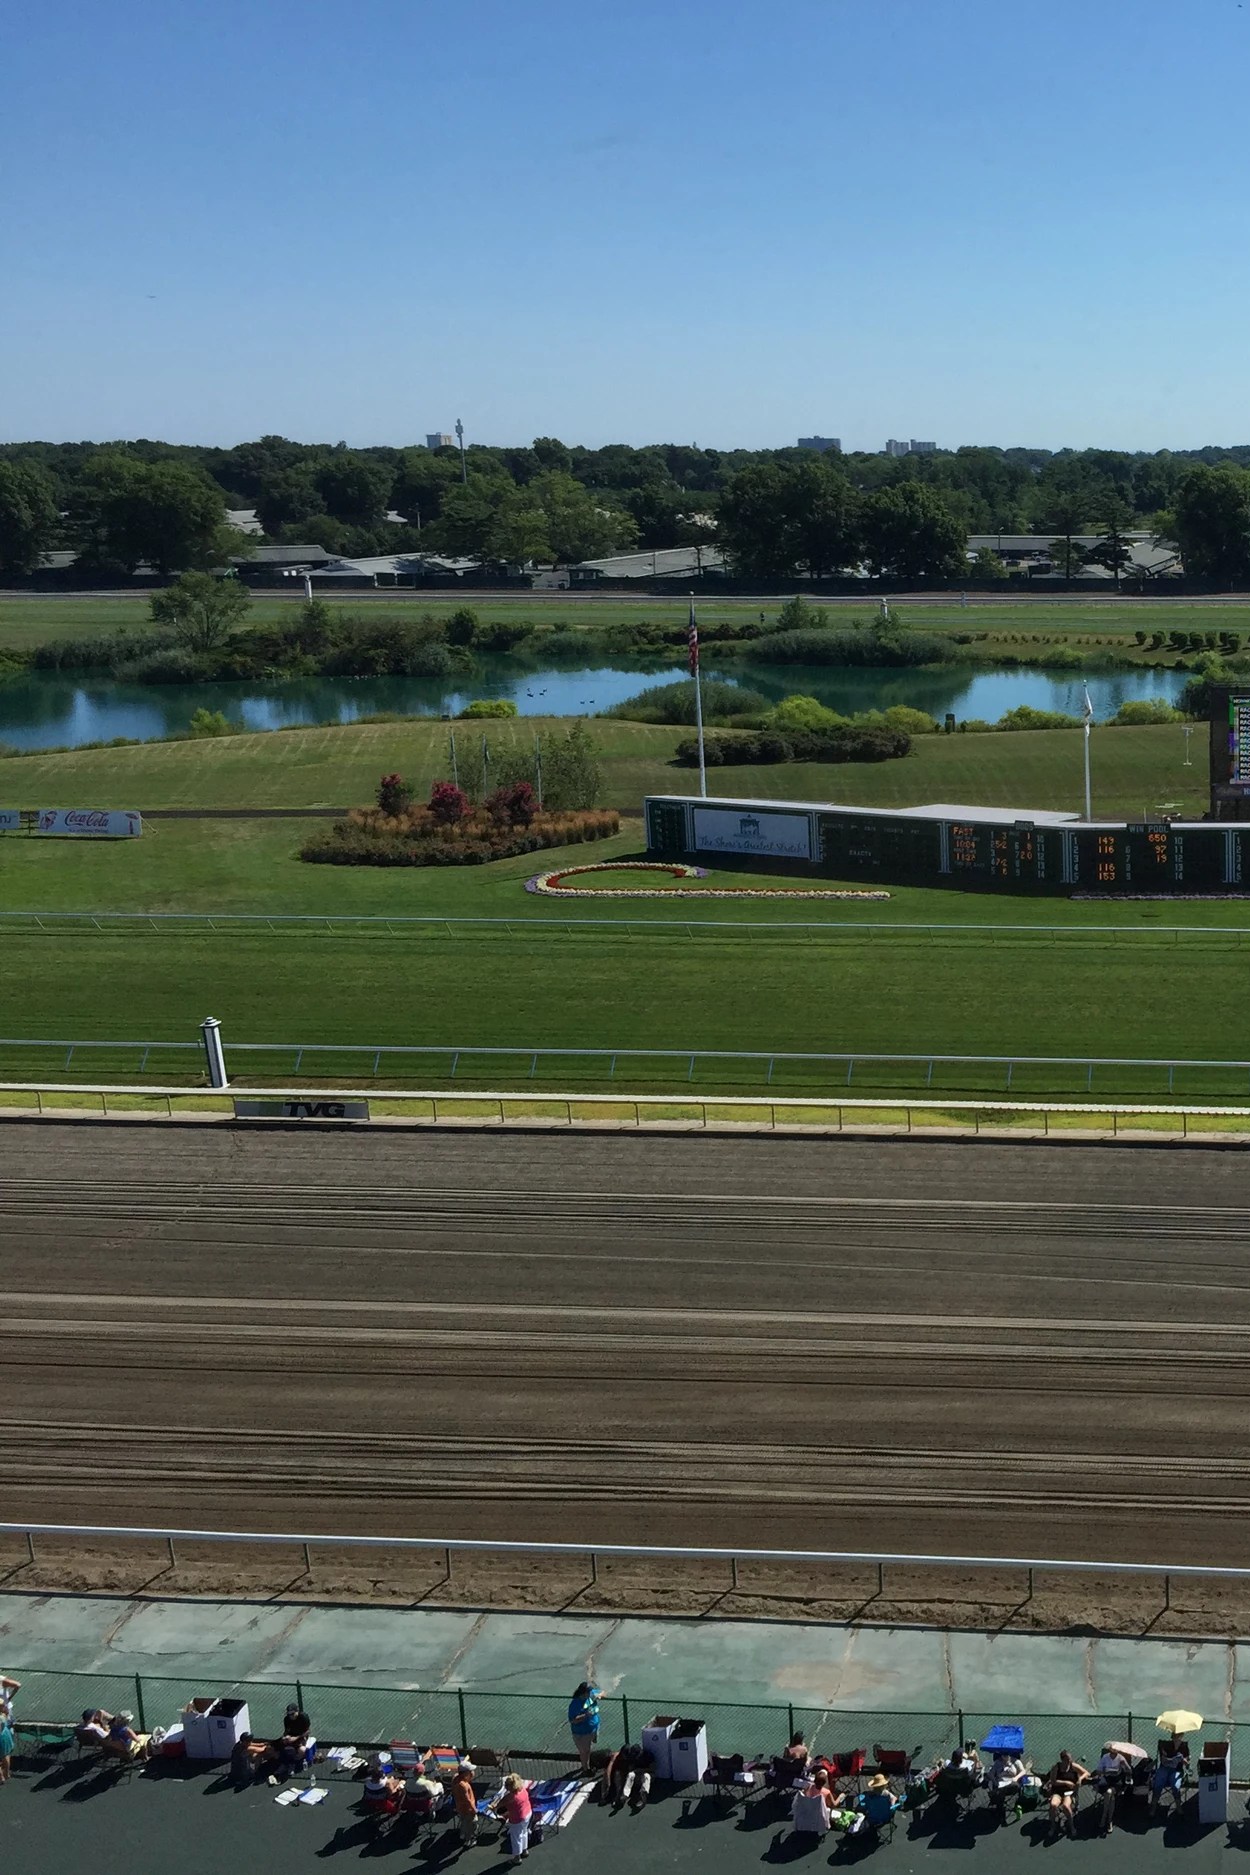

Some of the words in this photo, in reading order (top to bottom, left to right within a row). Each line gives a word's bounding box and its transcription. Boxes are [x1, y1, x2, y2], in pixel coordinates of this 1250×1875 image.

[952, 826, 974, 836] FAST
[1129, 825, 1144, 833] WIN
[1148, 825, 1168, 833] POOL
[1174, 837, 1183, 845] 10
[1098, 846, 1115, 854] 116
[1155, 846, 1166, 854] 97
[1174, 846, 1183, 854] 11
[1037, 852, 1044, 860] 12
[1098, 872, 1116, 880] 153
[284, 1102, 346, 1118] TVG
